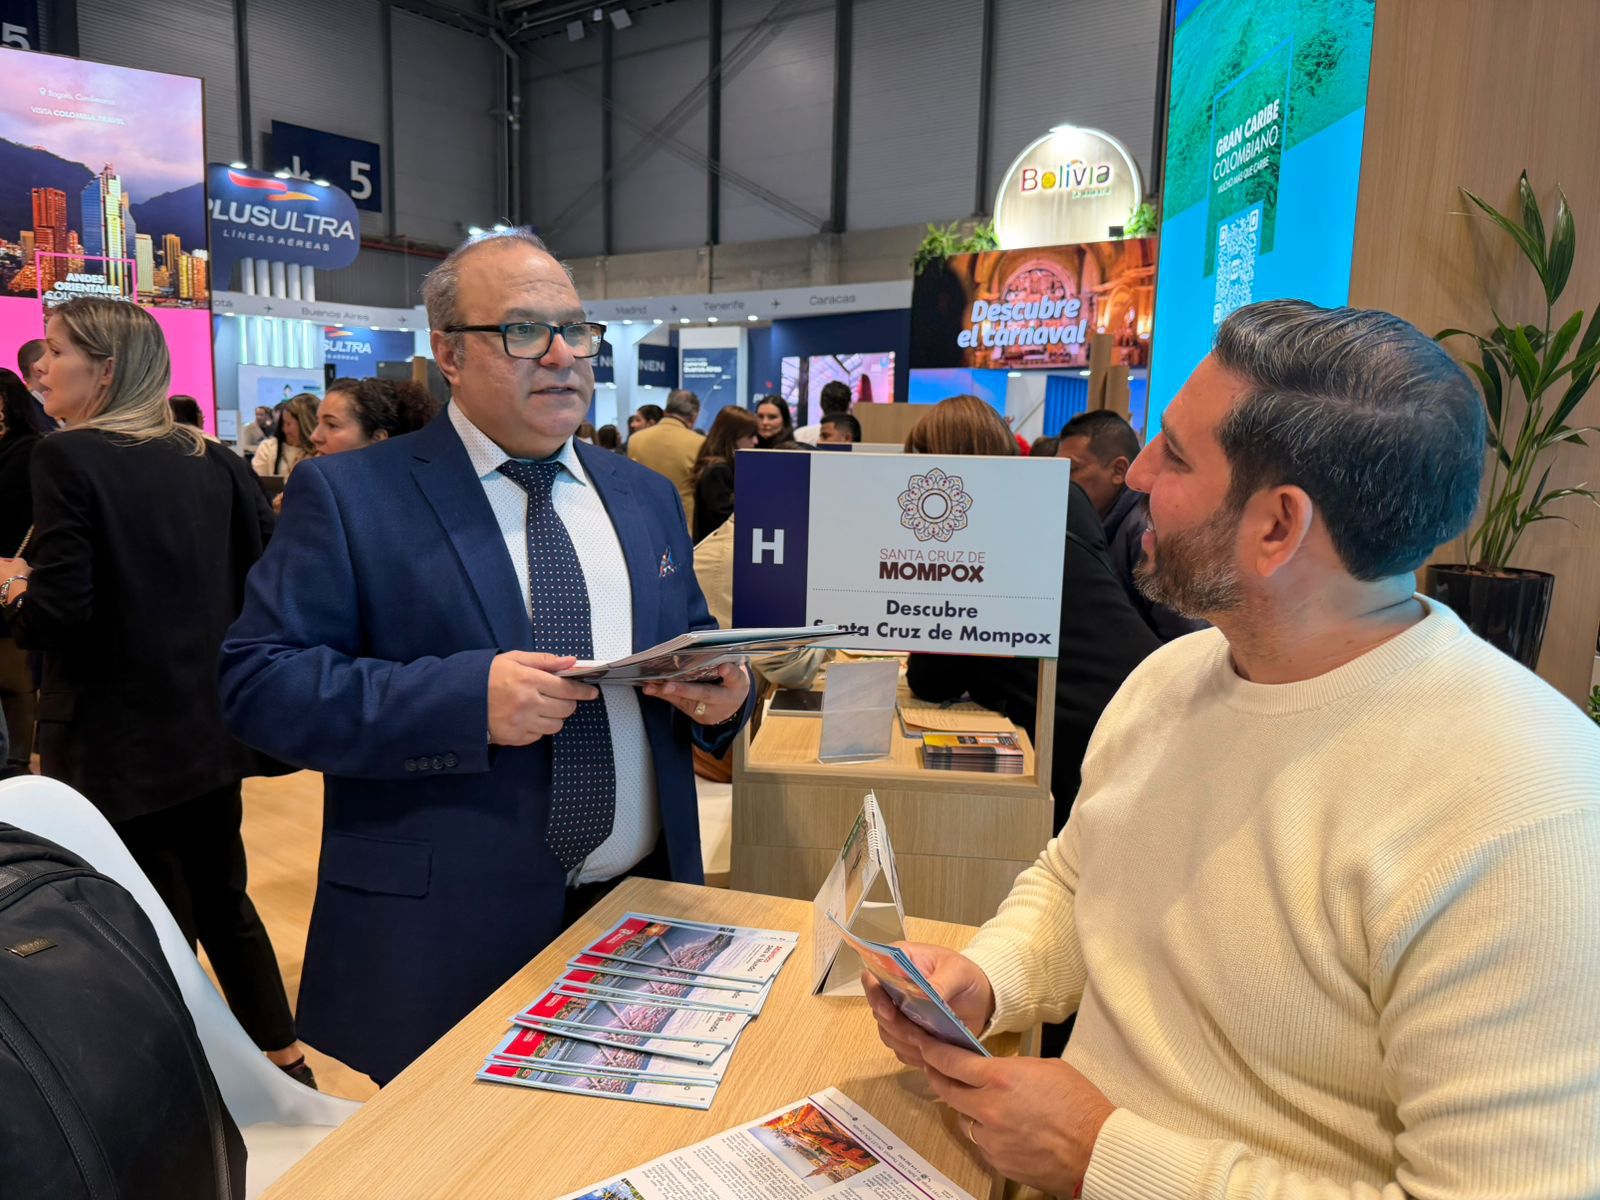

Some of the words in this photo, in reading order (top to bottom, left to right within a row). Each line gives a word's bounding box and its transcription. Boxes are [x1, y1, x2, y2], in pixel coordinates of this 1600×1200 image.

[2, 22, 31, 50] 5
[1216, 124, 1243, 158] GRAN
[1244, 98, 1280, 138] CARIBE
[1213, 125, 1279, 181] COLOMBIANO
[350, 160, 373, 200] 5
[1021, 161, 1110, 192] Bolivia
[208, 198, 355, 240] LUSULTRA
[53, 281, 121, 294] ORIENTALES
[66, 273, 105, 284] ANDES
[615, 305, 647, 315] Madrid
[703, 300, 744, 311] Tenerife
[809, 294, 856, 306] Caracas
[971, 295, 1081, 322] Descubre
[301, 307, 341, 319] Buenos
[343, 312, 370, 321] Aires
[957, 324, 979, 348] el
[982, 319, 1087, 347] carnaval
[752, 528, 784, 564] H
[880, 548, 924, 561] SANTA
[928, 550, 964, 563] CRUZ
[968, 551, 986, 564] DE
[879, 561, 985, 583] MOMPOX
[886, 600, 978, 619] Descubre
[814, 619, 869, 637] nta
[876, 622, 921, 639] Cruz
[928, 623, 953, 640] de
[960, 626, 1052, 647] Mompox
